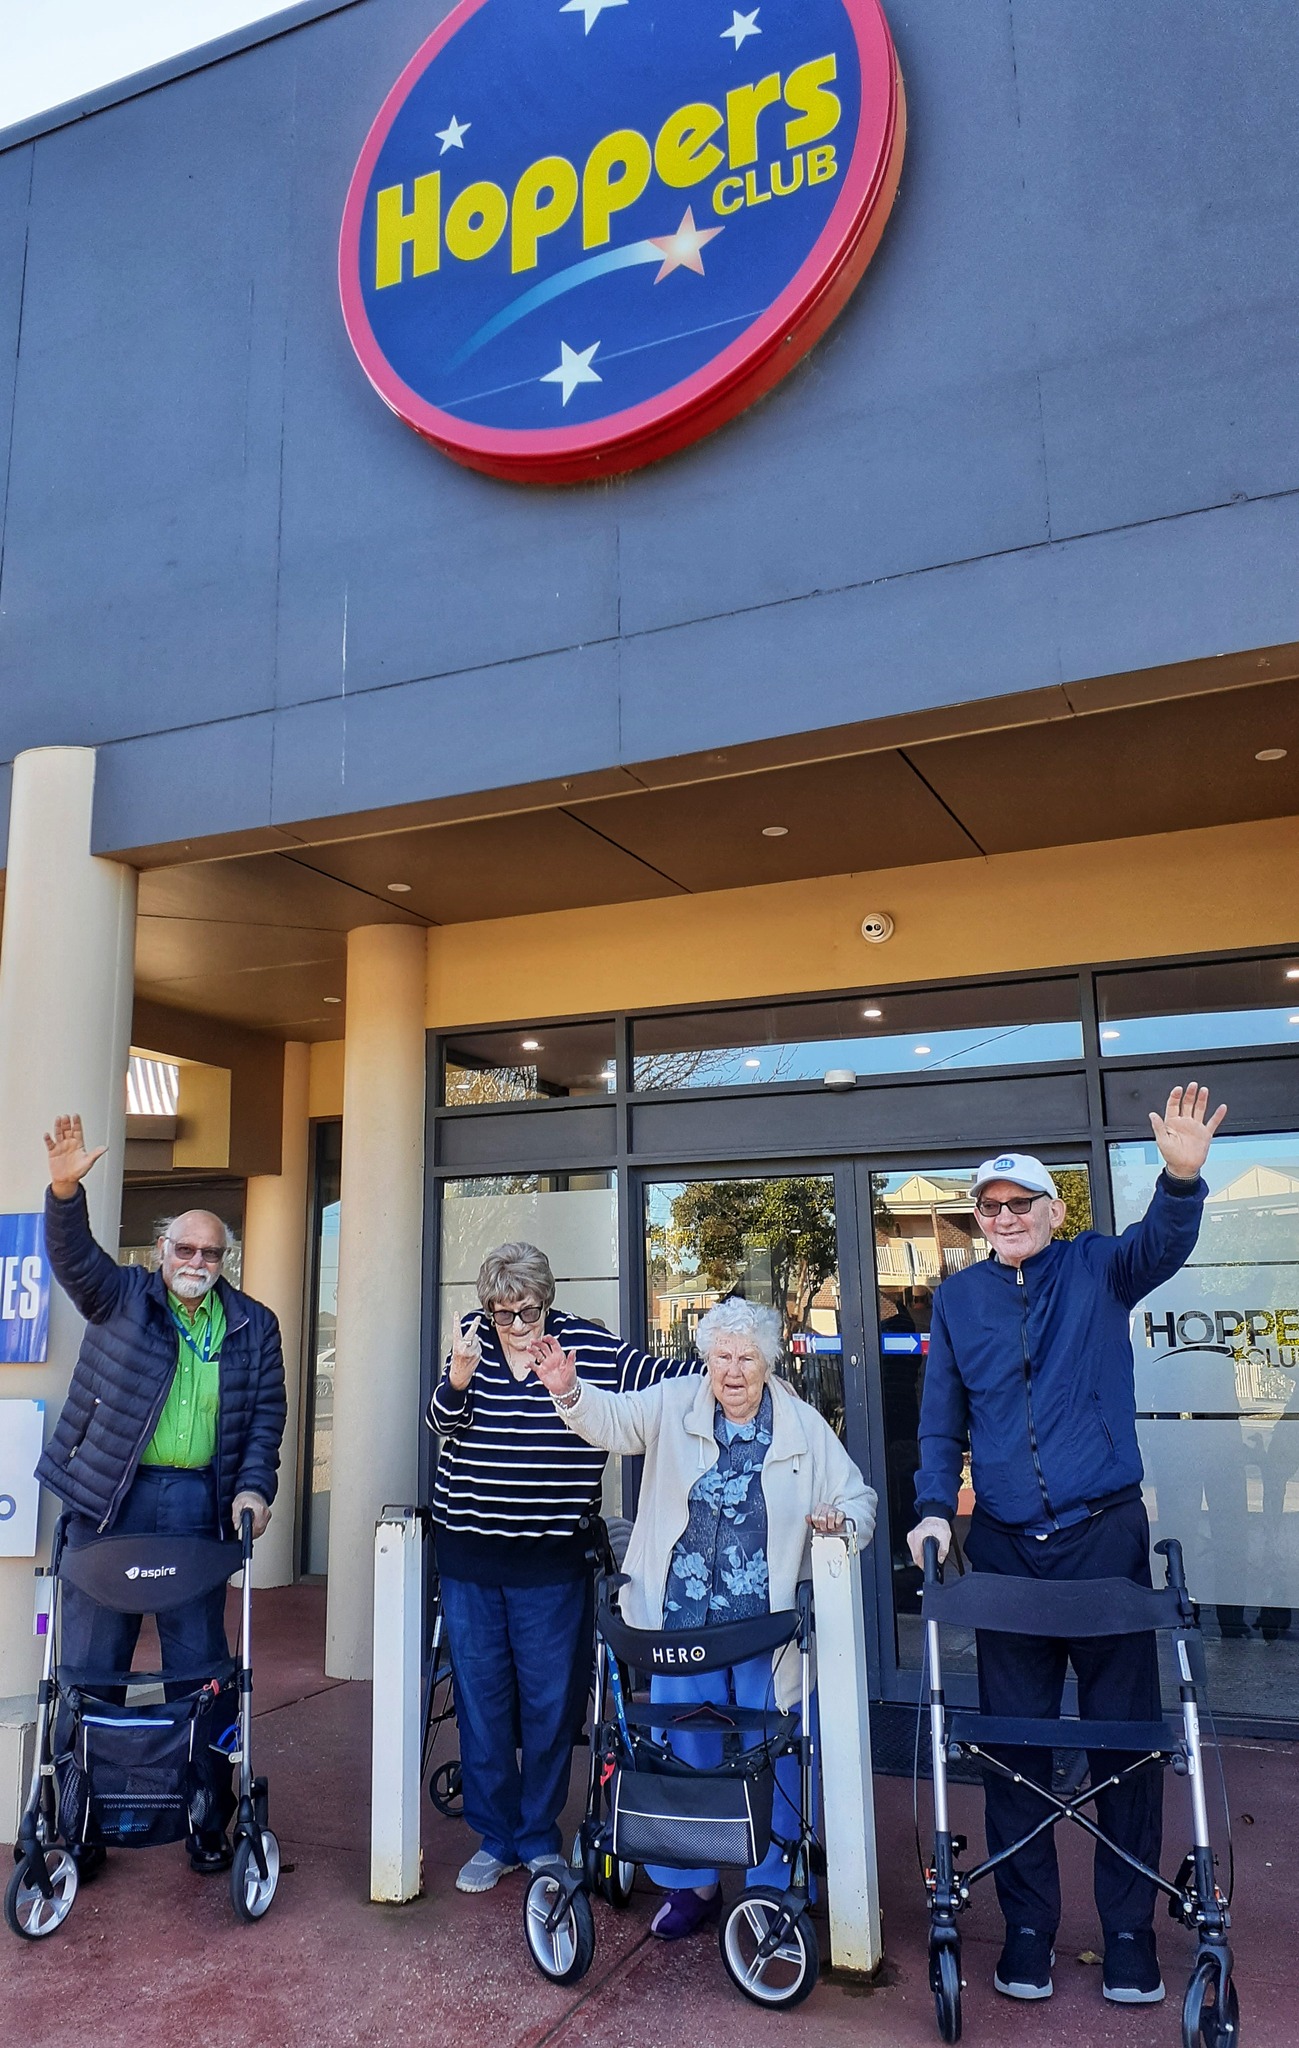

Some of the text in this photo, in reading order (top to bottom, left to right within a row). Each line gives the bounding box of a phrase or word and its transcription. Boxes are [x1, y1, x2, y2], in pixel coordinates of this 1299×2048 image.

[375, 53, 842, 290] Hoppers
[712, 144, 838, 216] CLUB
[0, 1255, 42, 1320] ES
[1144, 1310, 1299, 1348] HOPPE
[1246, 1347, 1299, 1368] CLU
[140, 1565, 176, 1579] aspire
[652, 1646, 706, 1663] HERO
